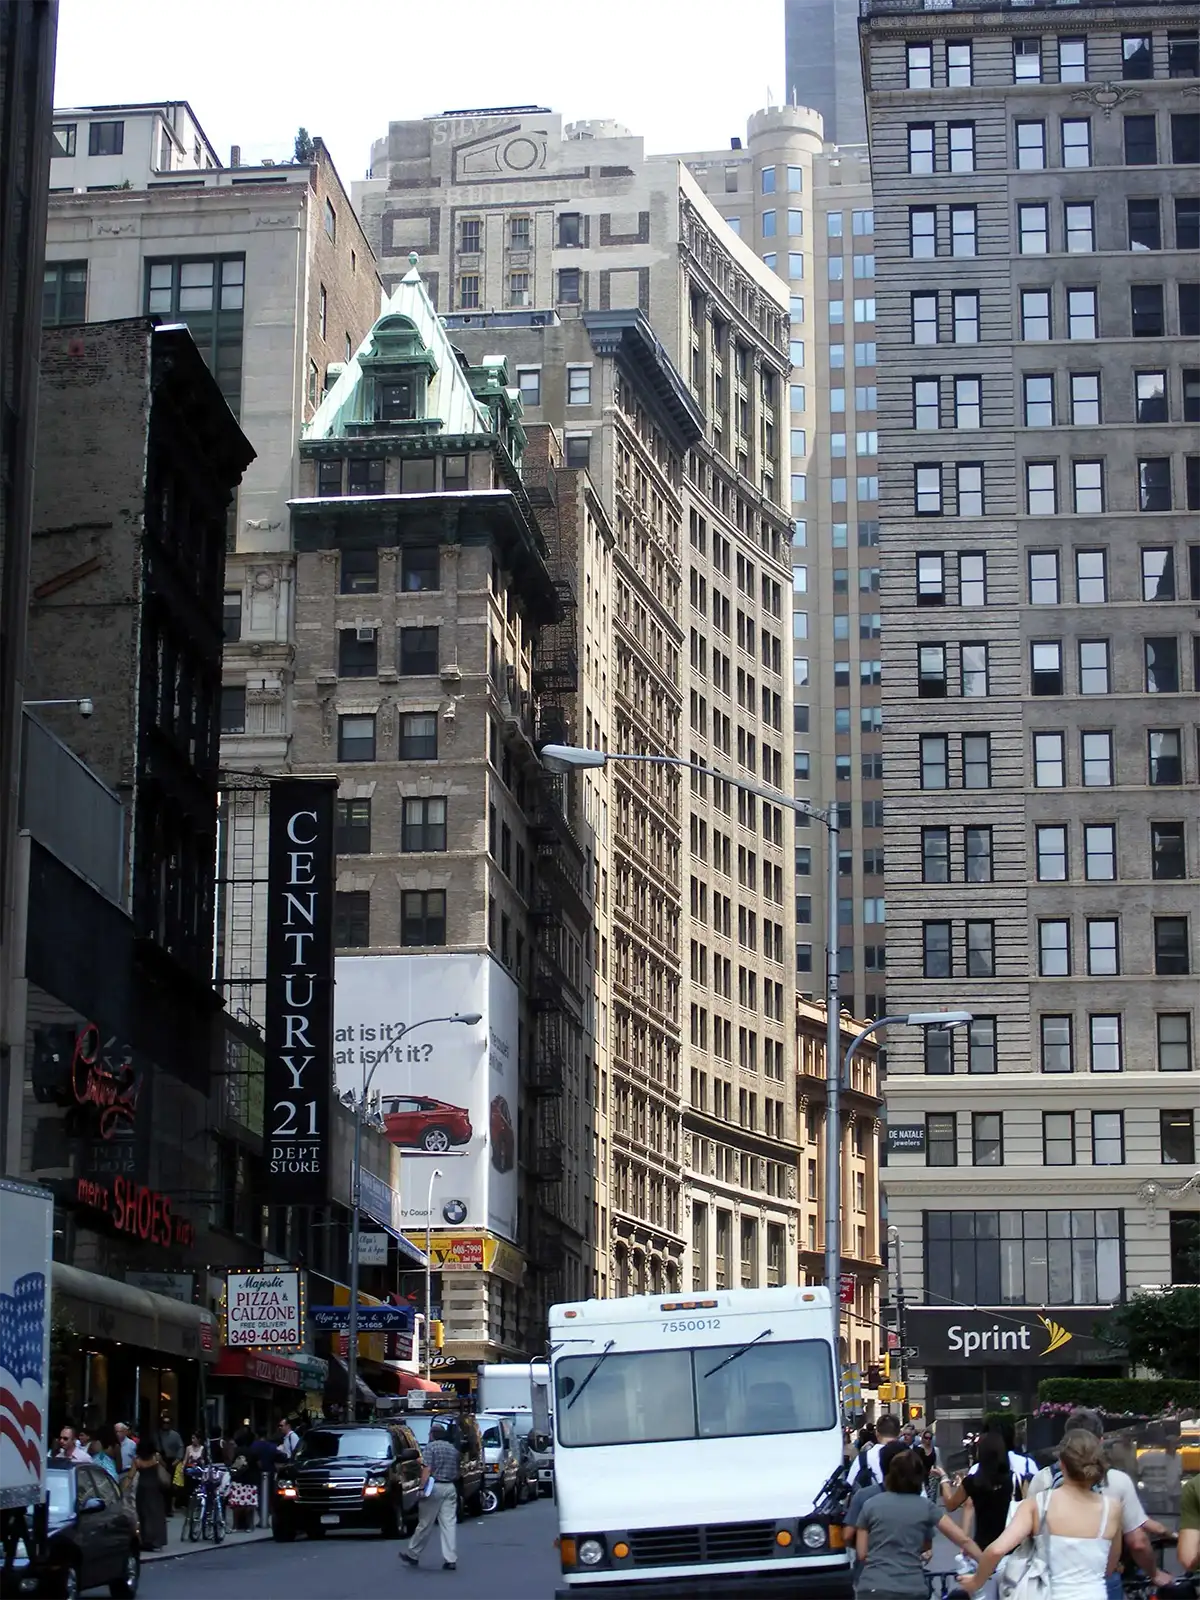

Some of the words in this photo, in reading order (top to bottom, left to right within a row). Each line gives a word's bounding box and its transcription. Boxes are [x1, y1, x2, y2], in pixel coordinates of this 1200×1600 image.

[282, 811, 319, 1090] CENTURY
[360, 1024, 376, 1042] is
[380, 1022, 406, 1041] it?
[360, 1045, 403, 1064] isn't
[407, 1044, 433, 1062] it?
[273, 1101, 321, 1136] 21
[889, 1130, 898, 1139] DE
[899, 1130, 924, 1139] NATALE
[893, 1139, 920, 1149] jewelers
[272, 1147, 320, 1160] DEPT
[270, 1160, 320, 1174] STORE
[113, 1174, 172, 1248] SHOES
[238, 1275, 284, 1292] Majestic
[237, 1292, 280, 1306] PIZZA
[282, 1293, 288, 1301] &
[231, 1306, 296, 1321] CALZONE
[315, 1312, 339, 1324] Olga's
[383, 1312, 399, 1324] Spa
[661, 1319, 721, 1333] 7550012
[231, 1328, 297, 1344] 349-4046
[948, 1325, 1031, 1357] Sprint
